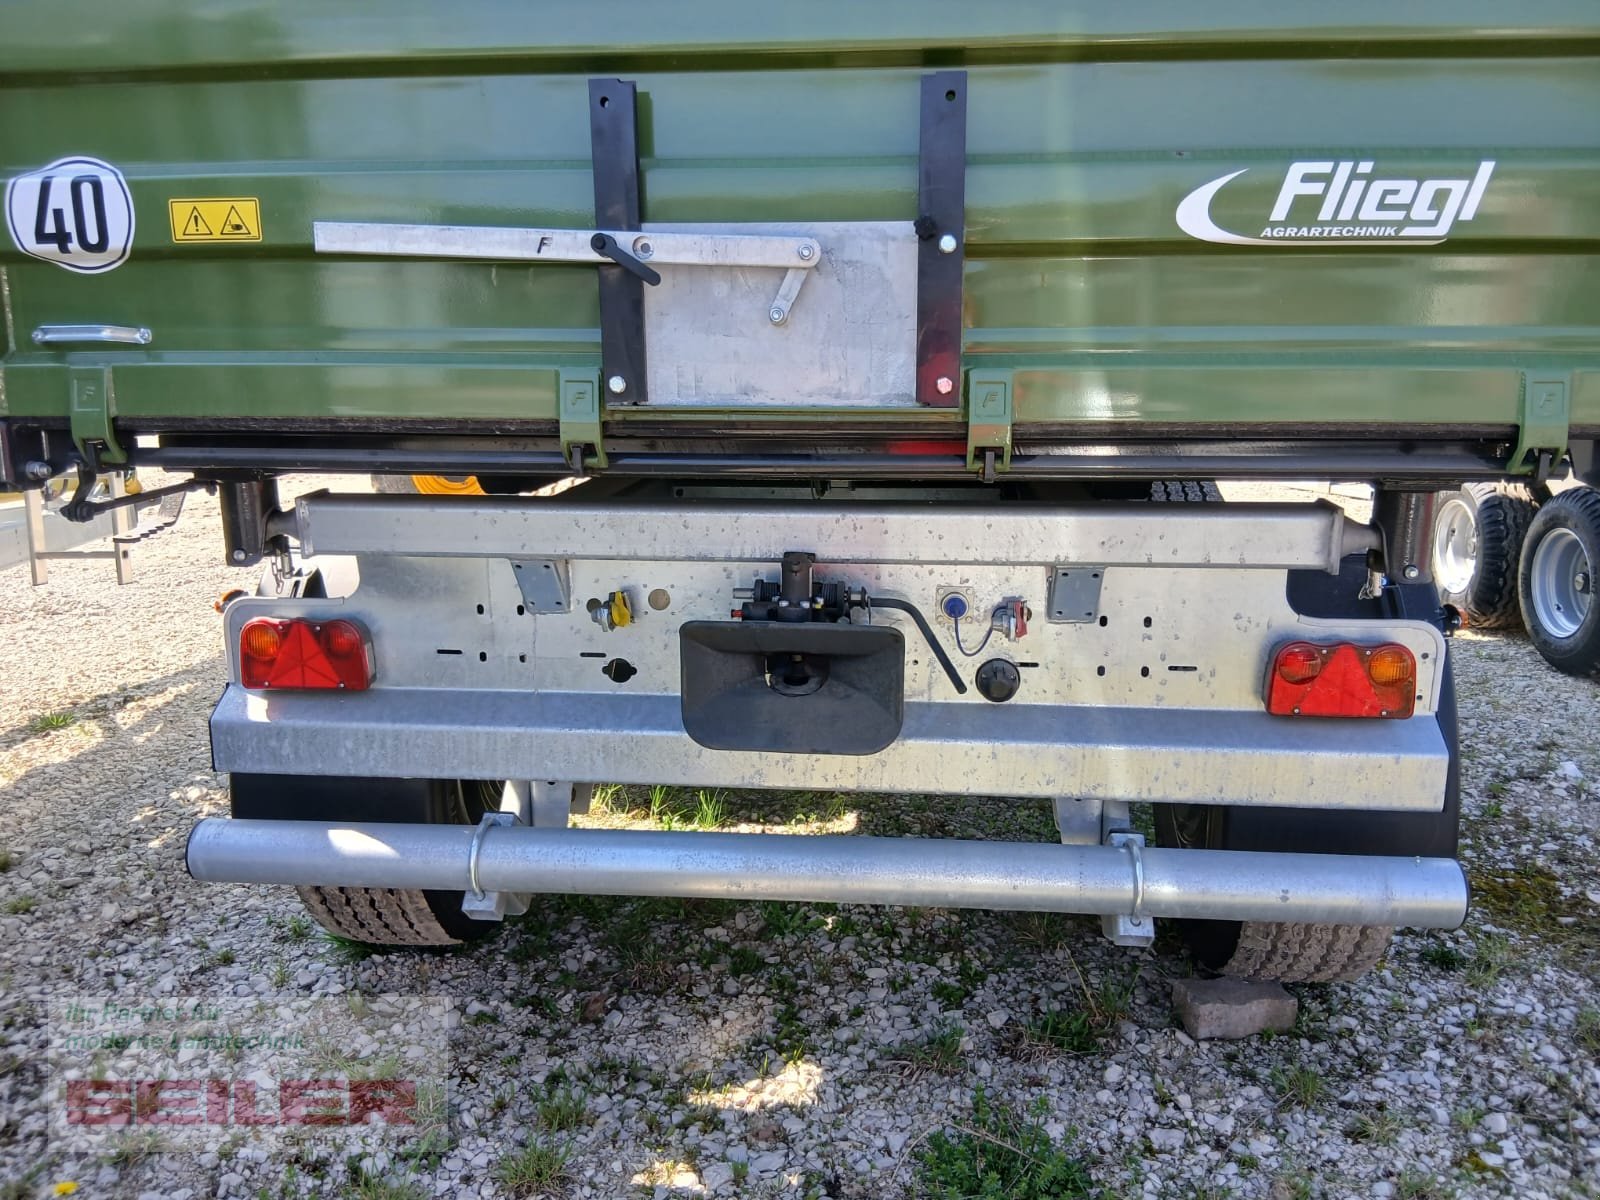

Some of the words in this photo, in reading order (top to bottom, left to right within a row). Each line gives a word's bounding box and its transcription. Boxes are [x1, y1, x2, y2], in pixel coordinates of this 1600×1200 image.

[35, 174, 109, 254] 40
[1260, 226, 1398, 238] AGRARTECHNIK
[1269, 161, 1495, 237] Fliegl
